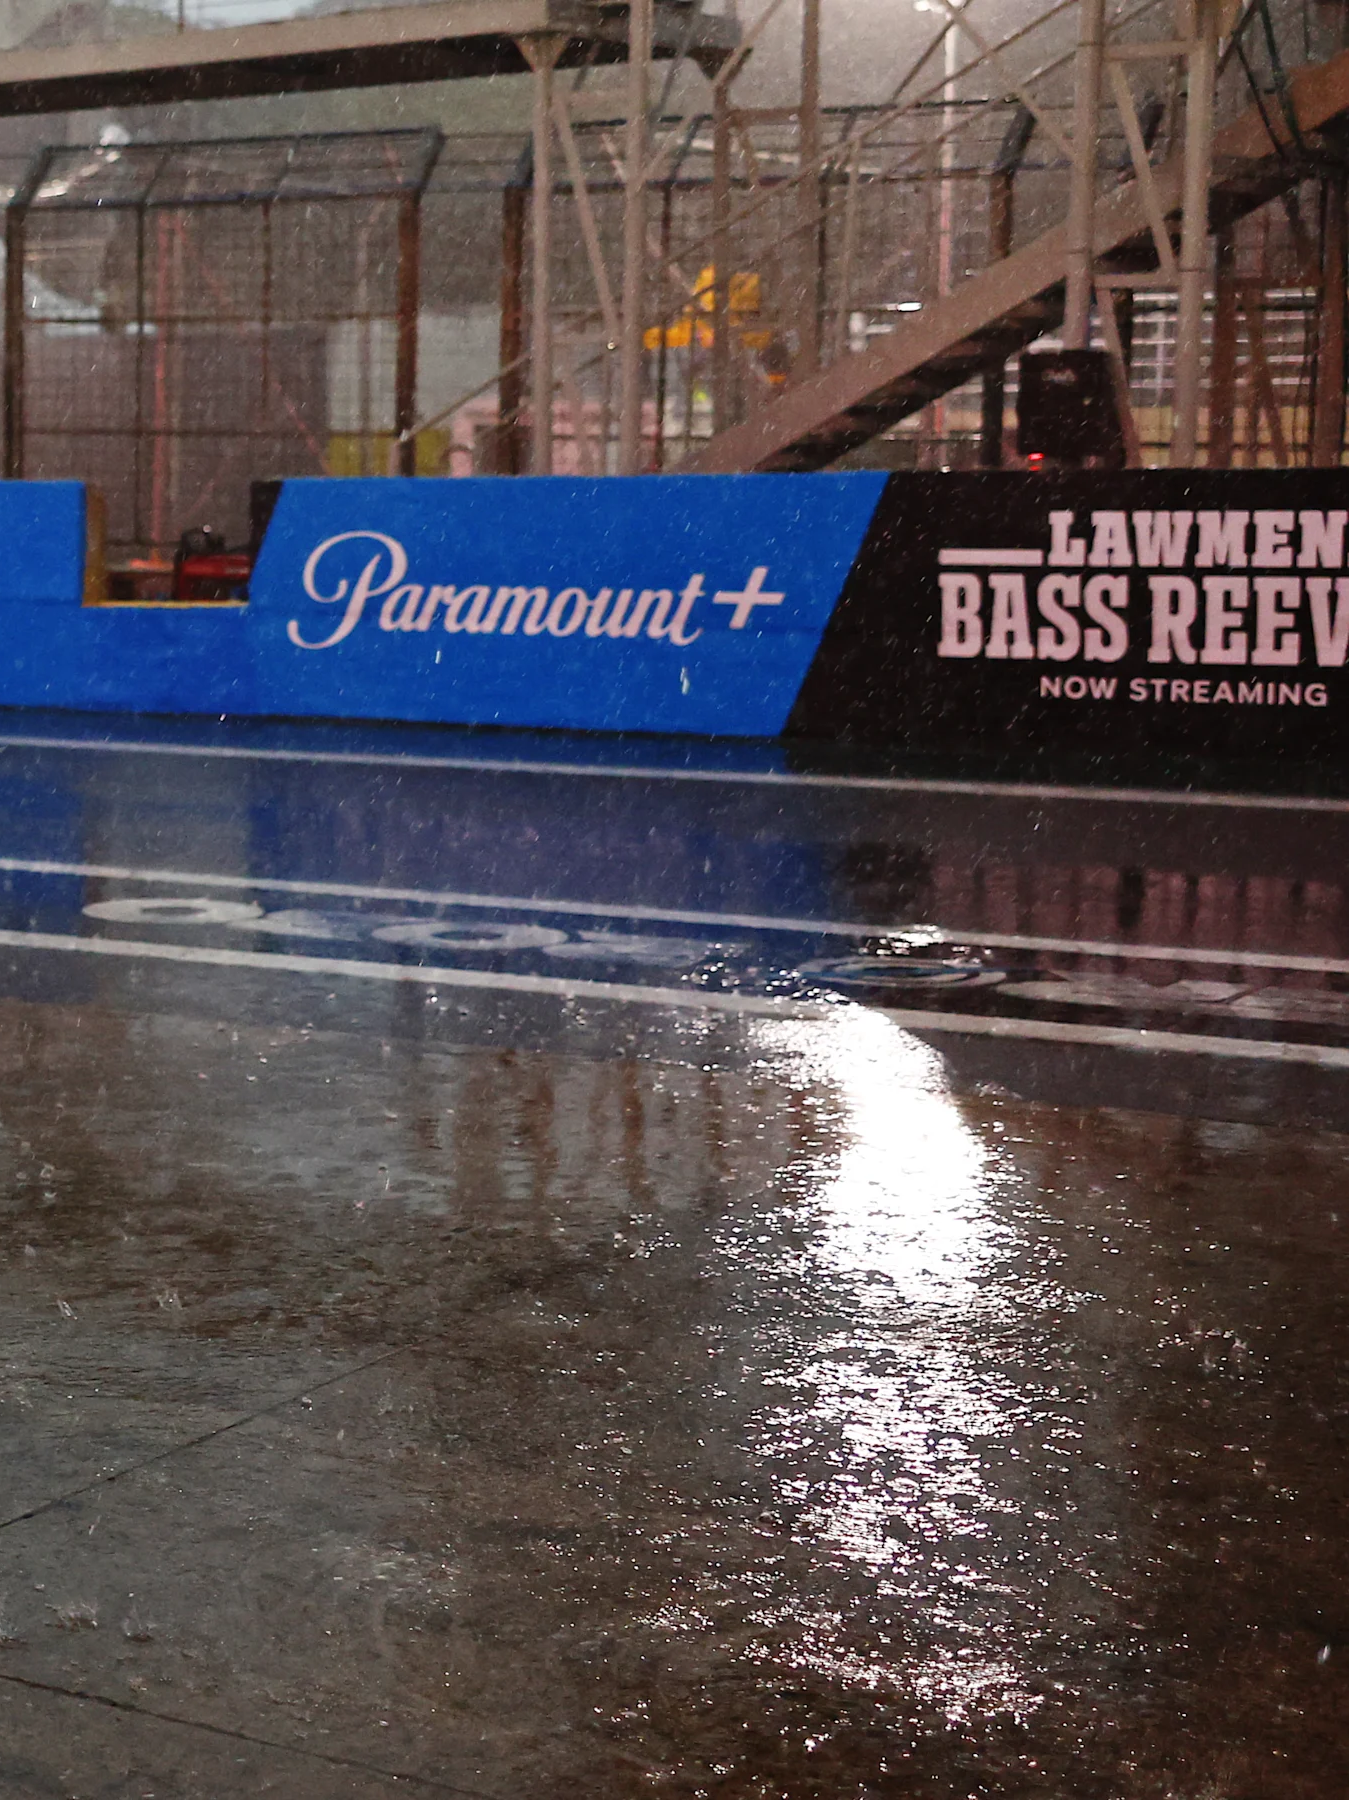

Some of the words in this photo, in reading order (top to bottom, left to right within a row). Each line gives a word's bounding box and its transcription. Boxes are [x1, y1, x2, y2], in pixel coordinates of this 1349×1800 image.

[1047, 509, 1349, 568] LAWMEN
[286, 530, 786, 650] Paramount+
[937, 571, 1130, 663] BASS
[1147, 573, 1349, 667] REEV
[1039, 675, 1118, 700] NOW
[1129, 677, 1328, 708] STREAMING
